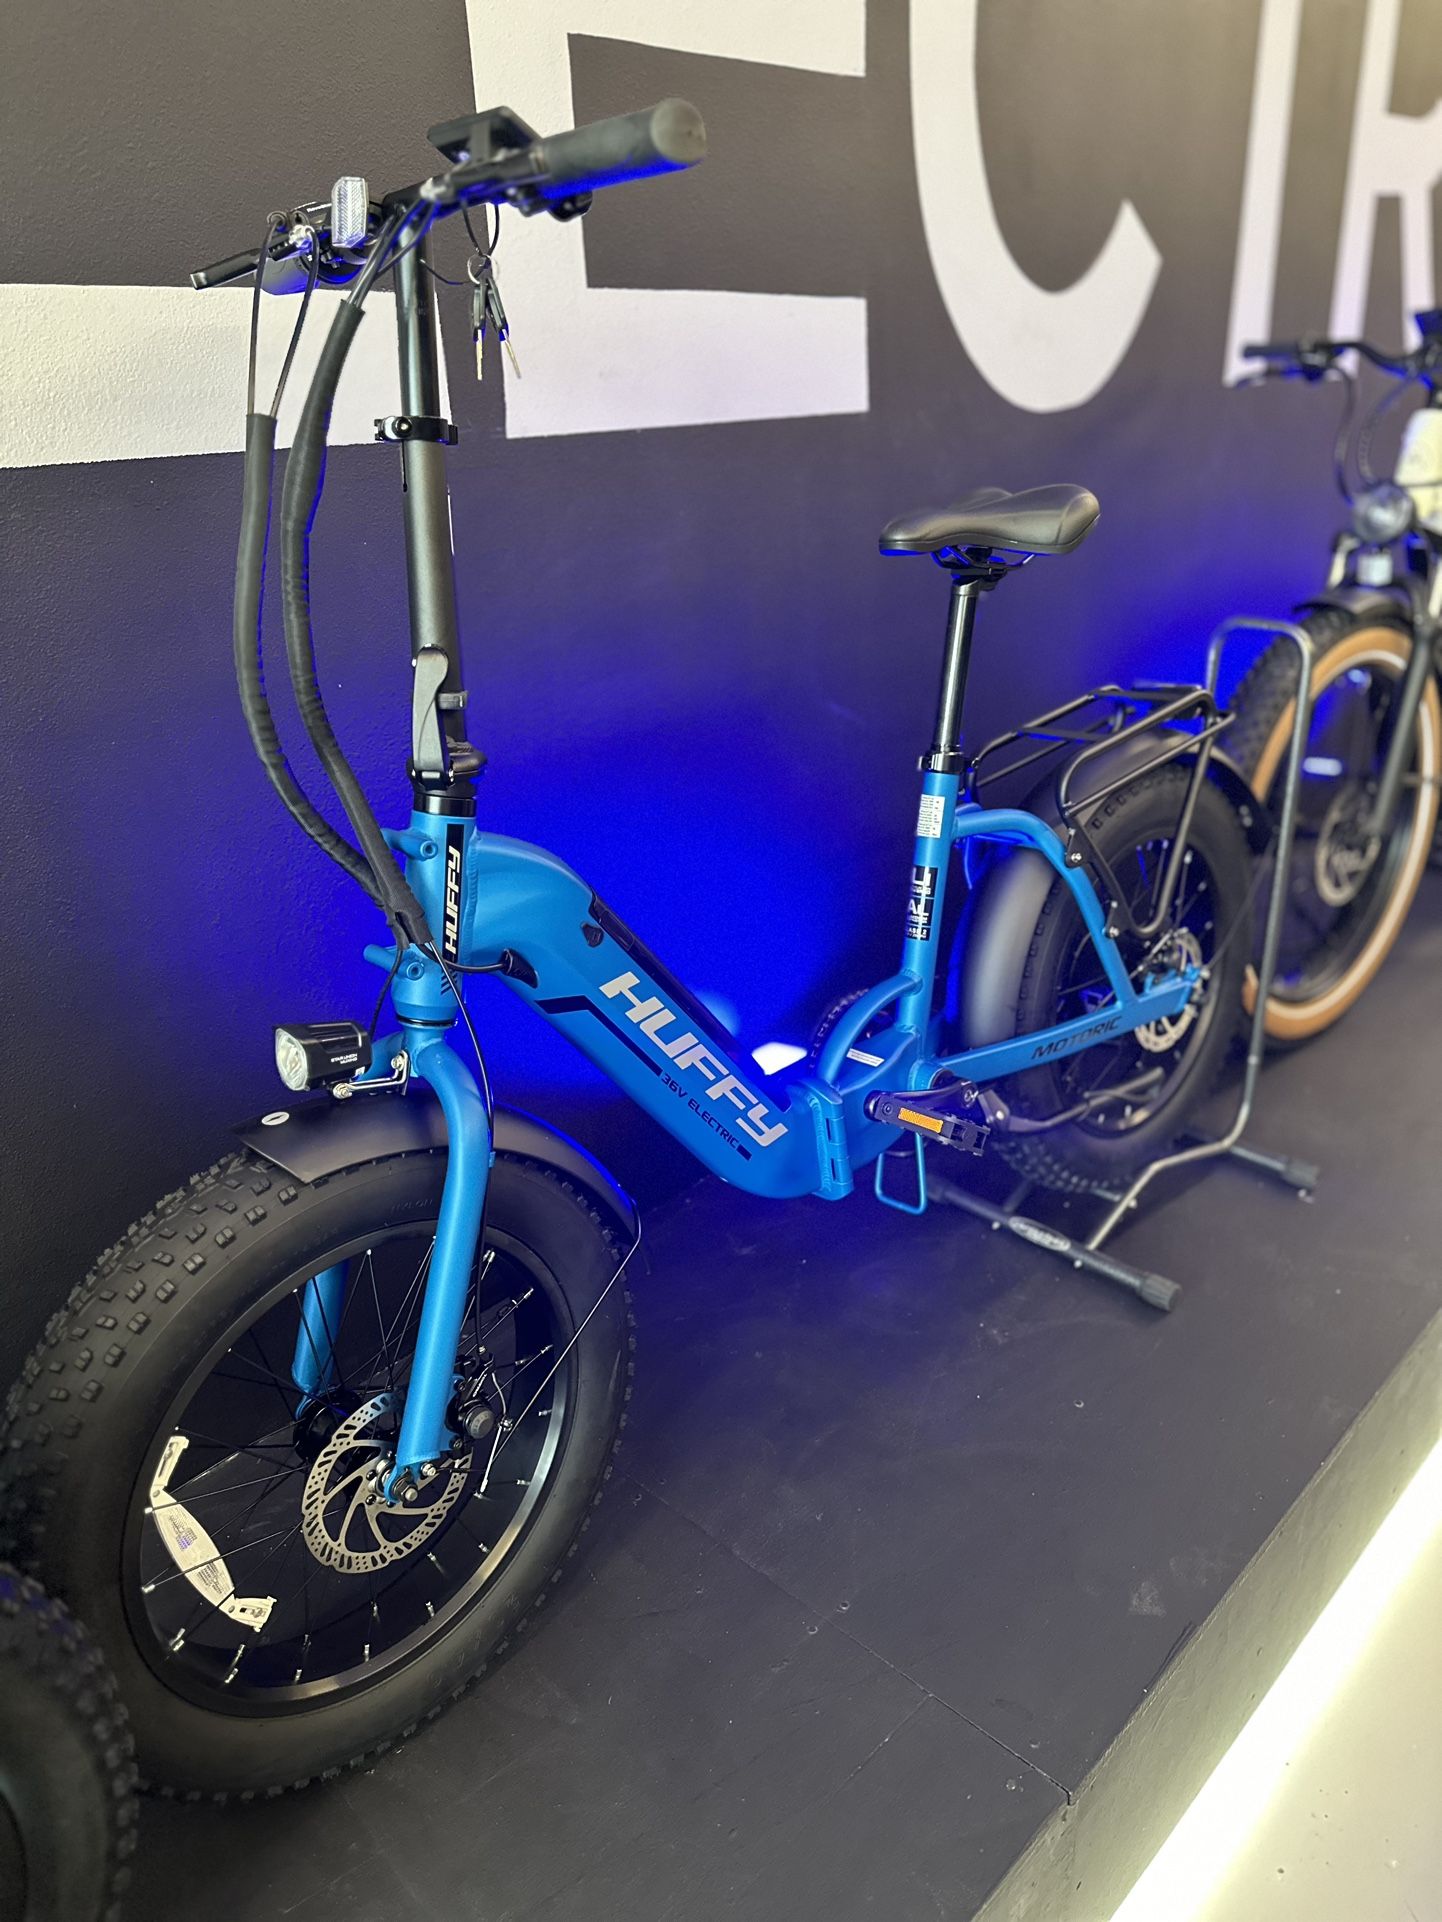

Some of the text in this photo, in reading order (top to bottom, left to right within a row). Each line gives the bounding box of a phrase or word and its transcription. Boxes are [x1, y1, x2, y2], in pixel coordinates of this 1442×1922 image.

[445, 845, 461, 955] HUFFY
[599, 971, 789, 1147] HUFFY
[1031, 1017, 1122, 1060] MOTORIC
[661, 1073, 740, 1149] 36V ELECTRIC
